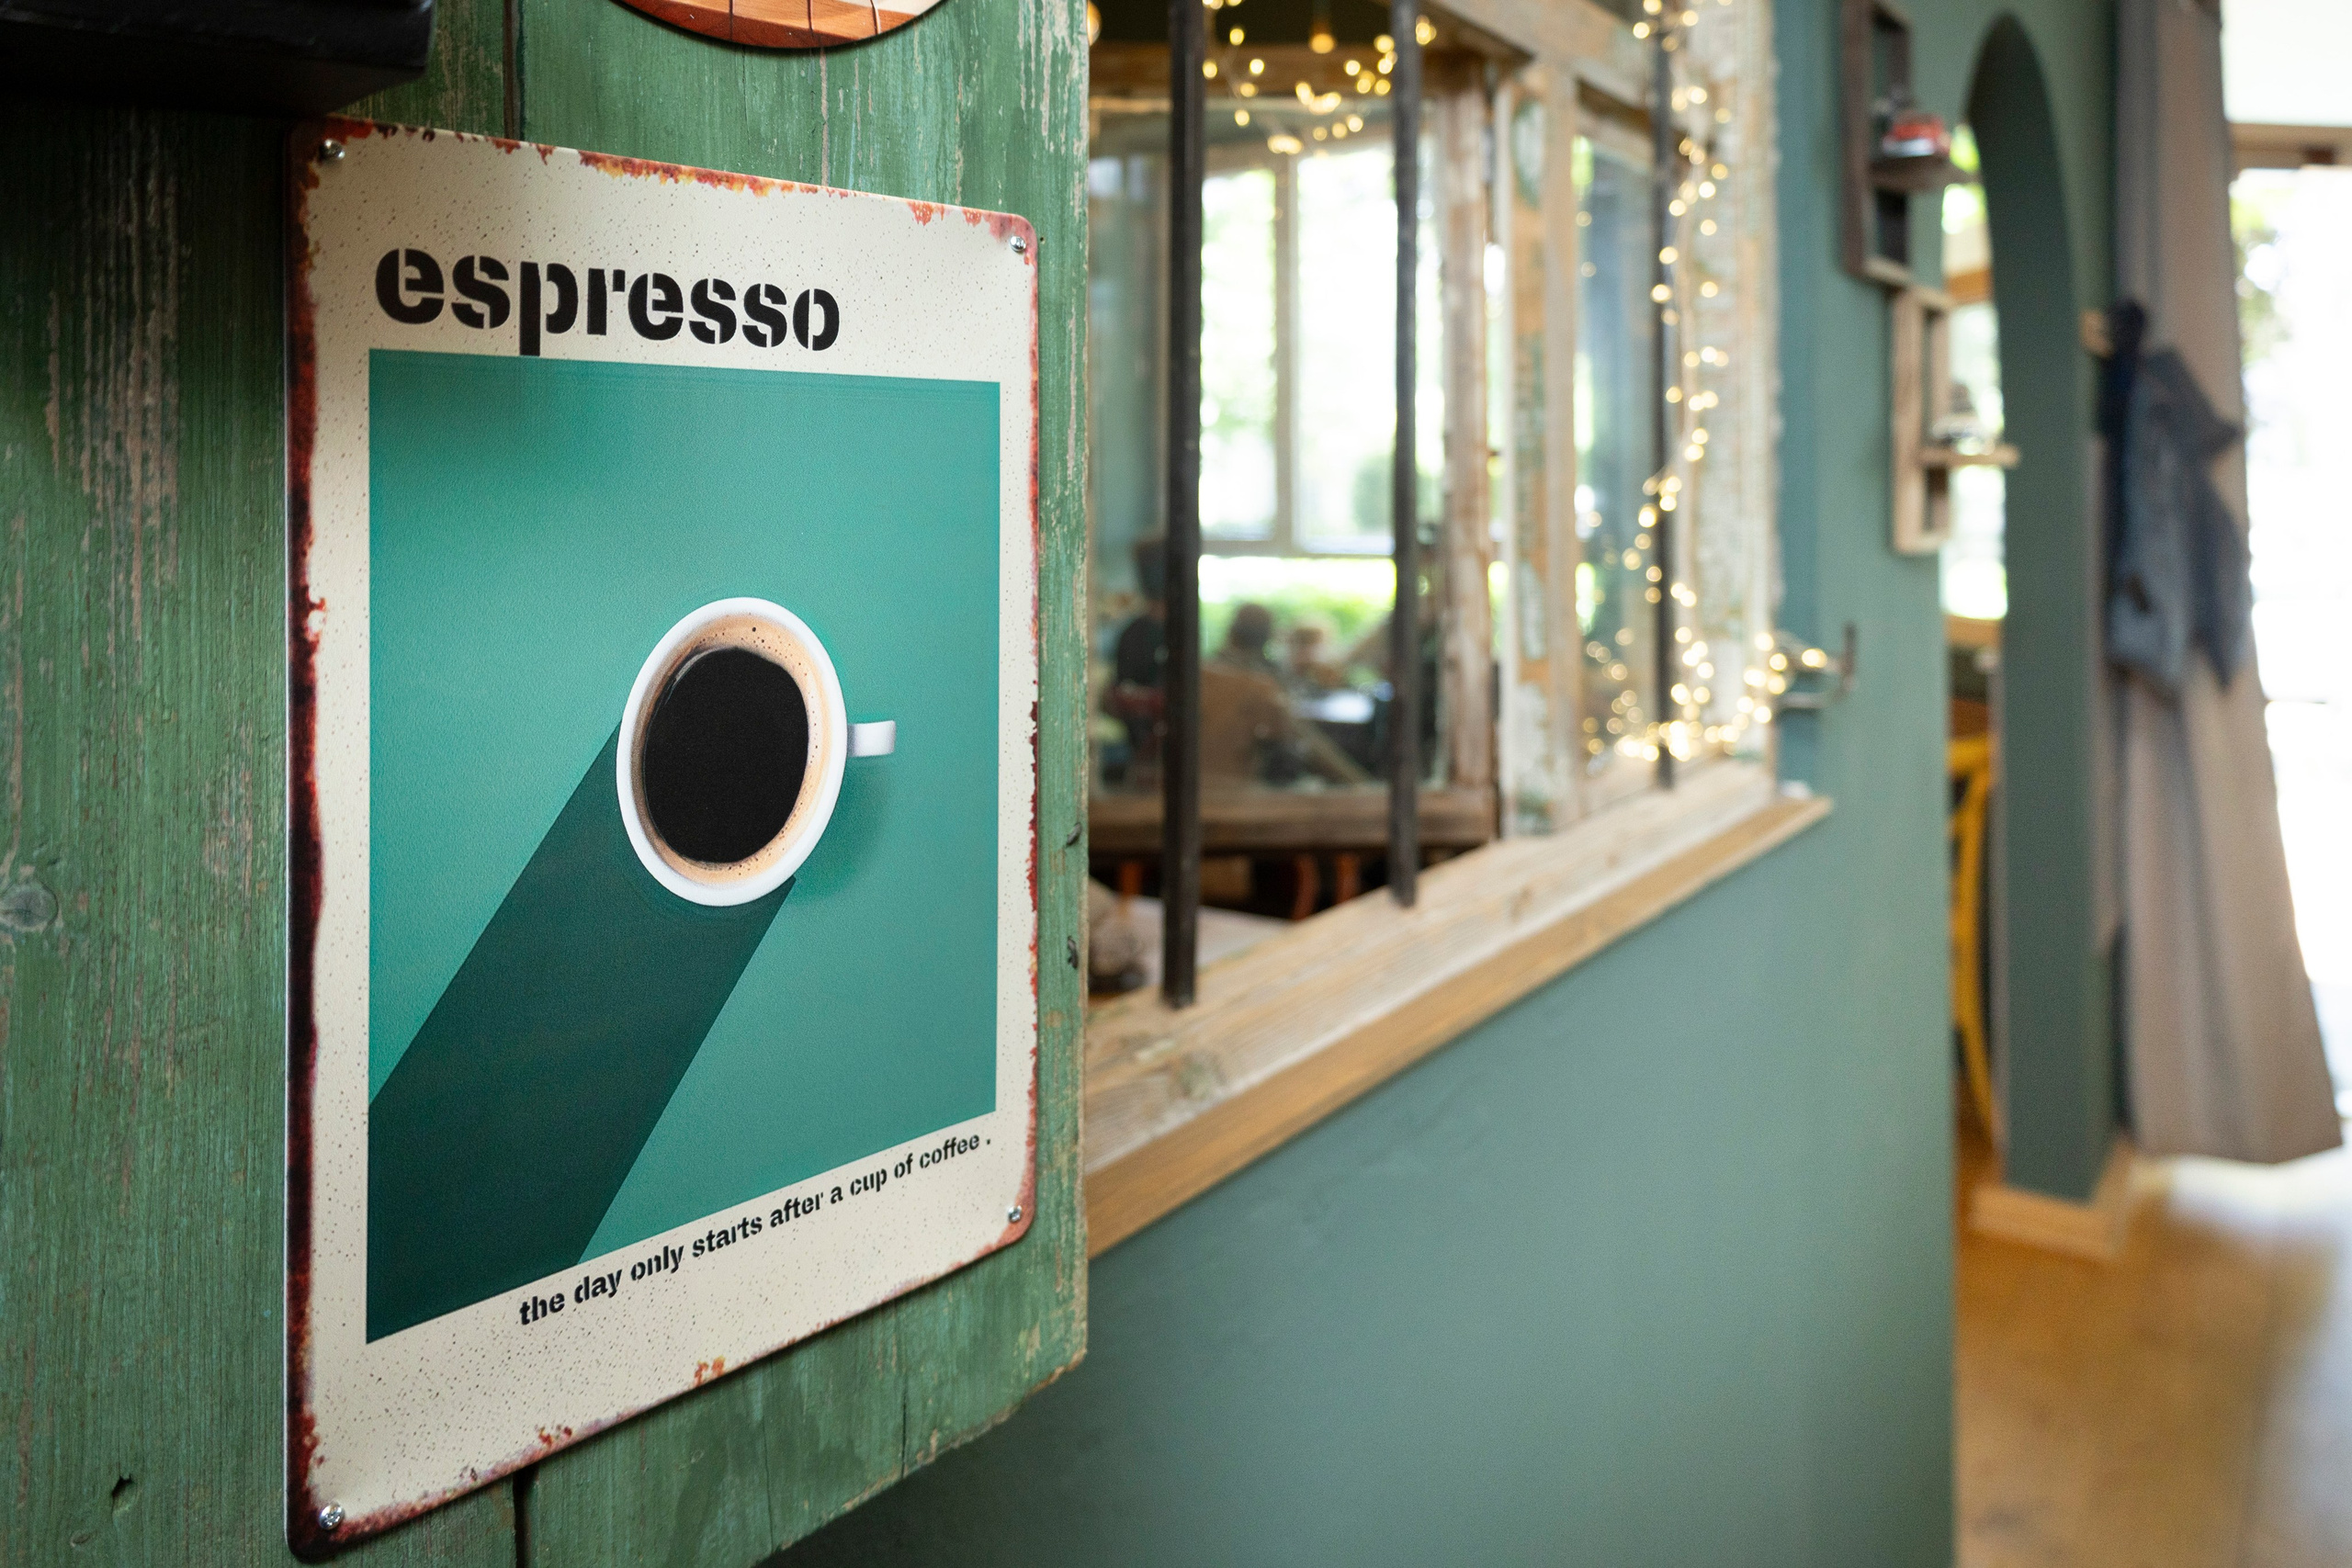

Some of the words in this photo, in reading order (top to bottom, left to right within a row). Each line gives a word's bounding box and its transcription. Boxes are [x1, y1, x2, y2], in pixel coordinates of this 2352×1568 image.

[375, 247, 840, 357] espresso
[519, 1292, 565, 1325] the
[574, 1269, 622, 1299] day
[630, 1245, 684, 1281] only
[692, 1215, 763, 1258] starts
[770, 1191, 824, 1228] after
[831, 1185, 843, 1204] a
[850, 1168, 888, 1192] cup
[894, 1152, 913, 1179] of
